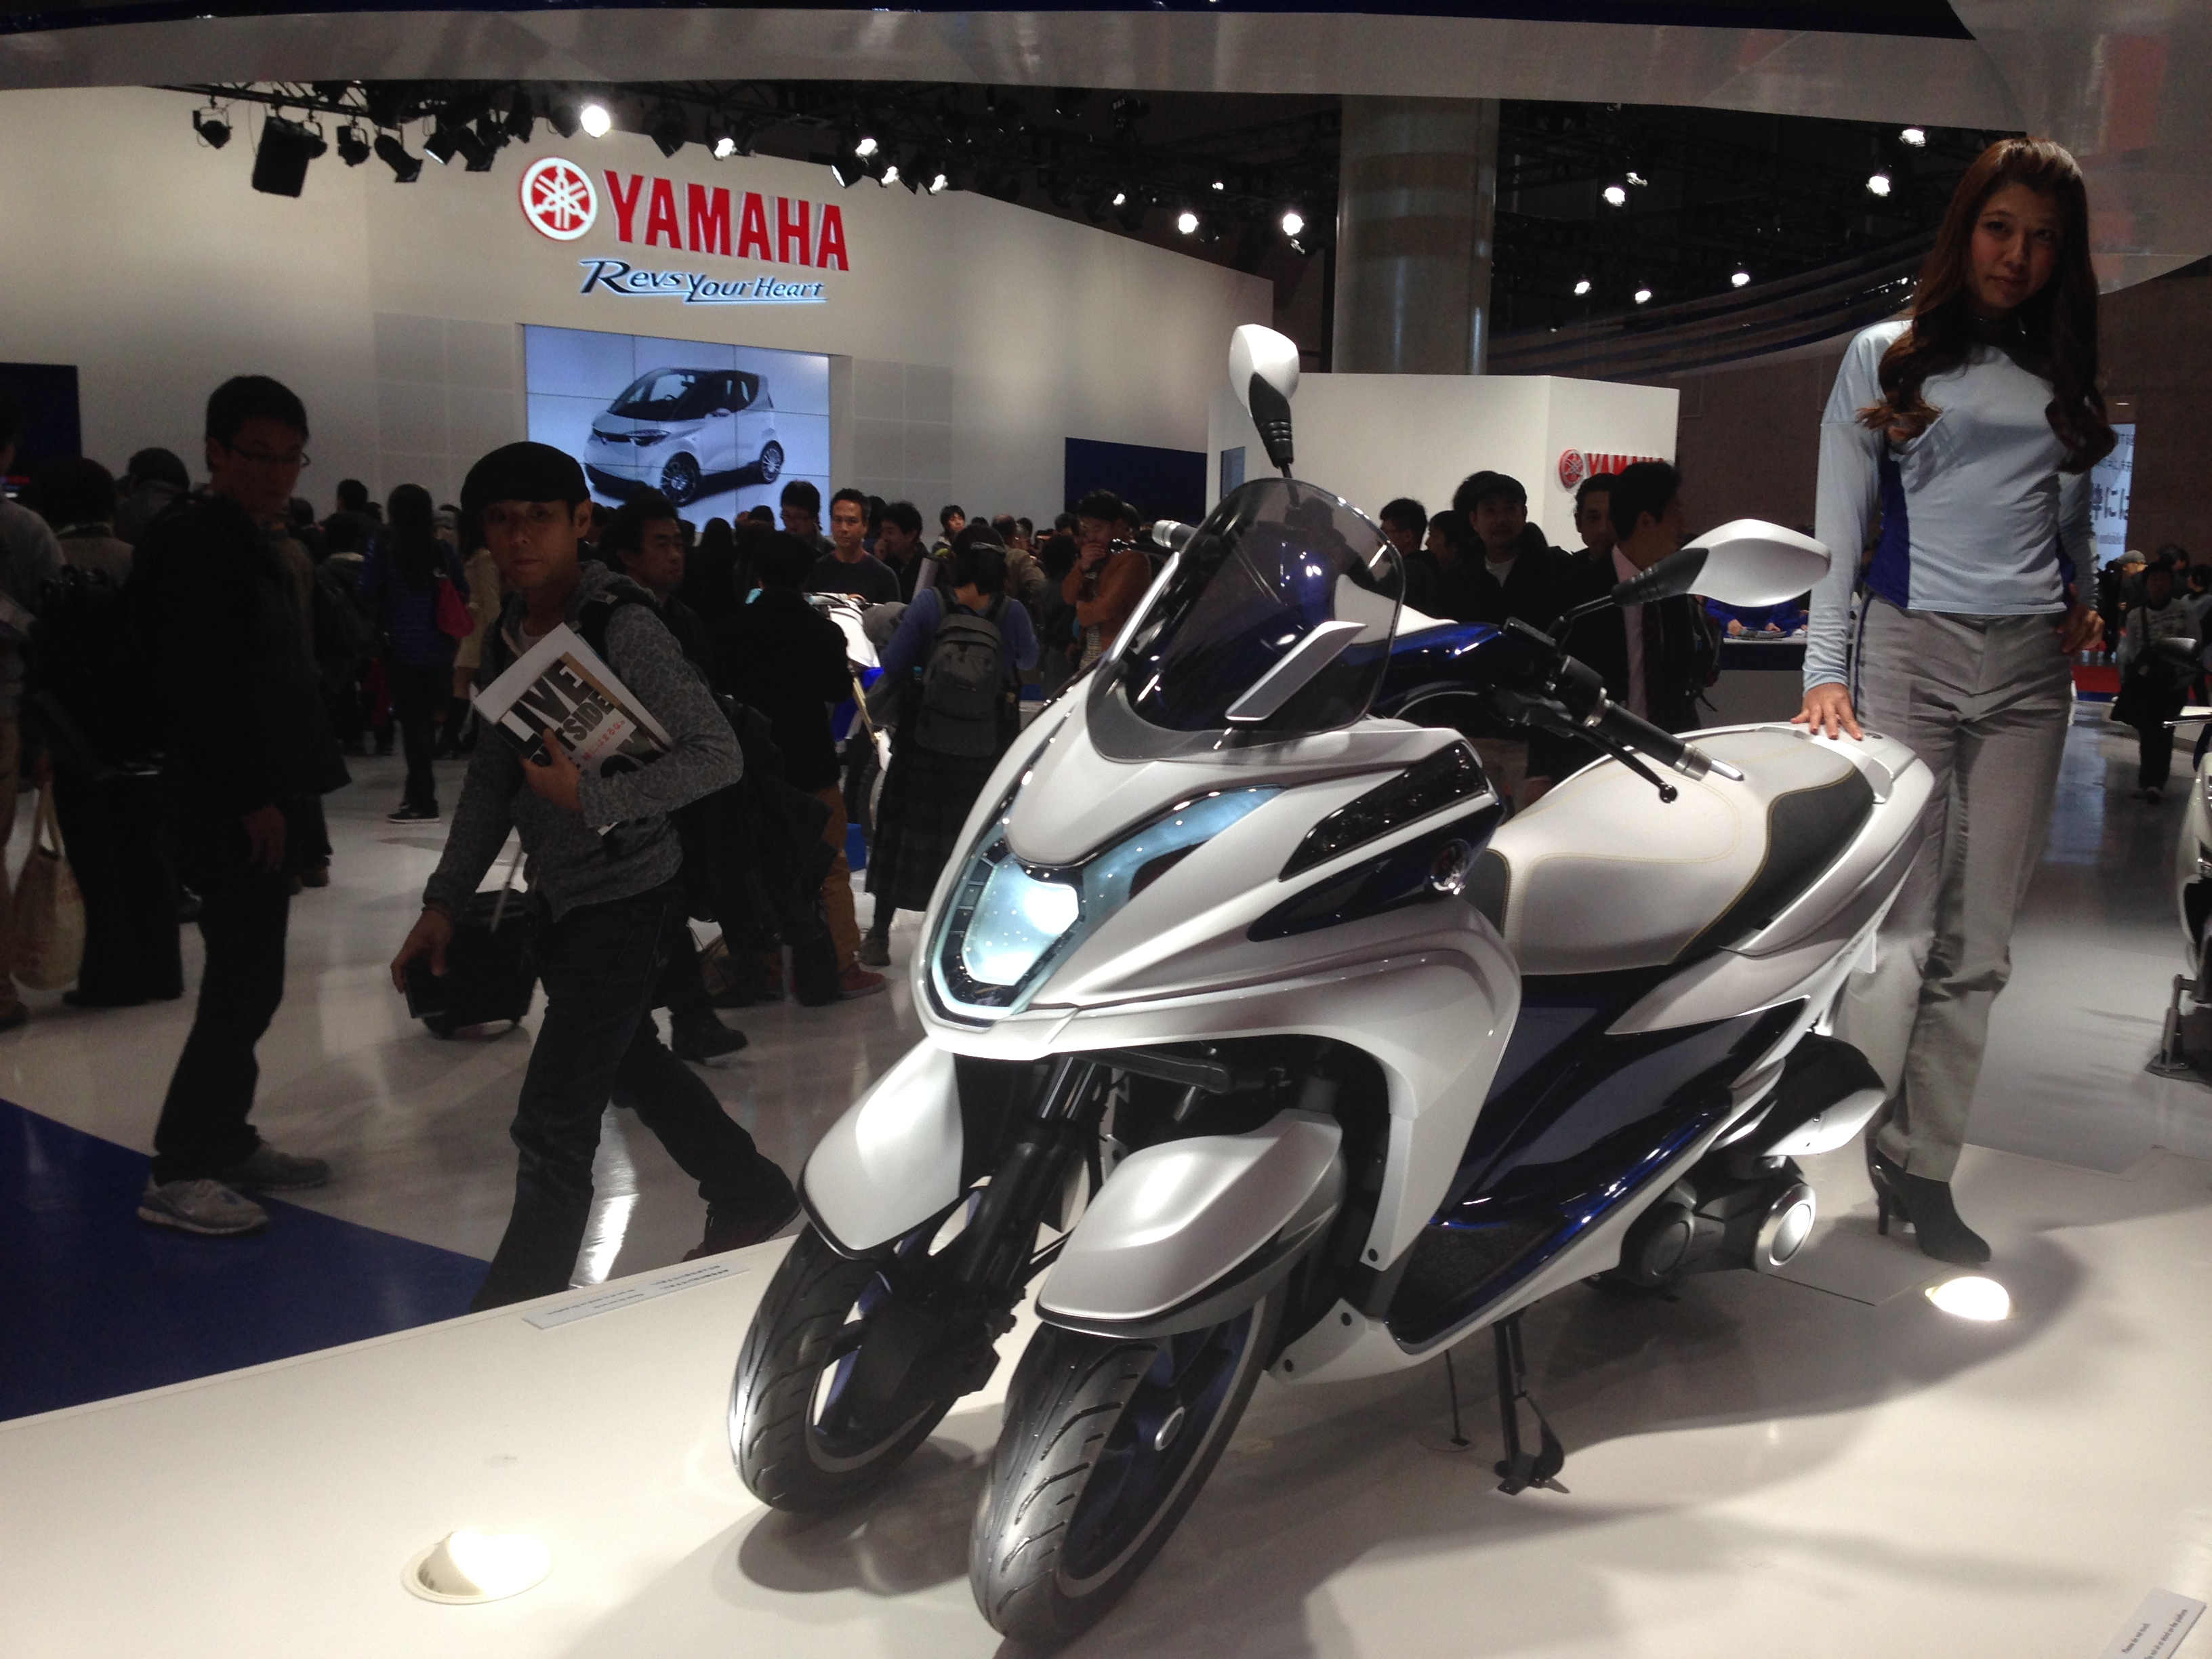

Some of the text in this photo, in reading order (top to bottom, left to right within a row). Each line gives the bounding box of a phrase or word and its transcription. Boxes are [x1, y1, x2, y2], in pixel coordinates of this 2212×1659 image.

[602, 169, 849, 271] YAMAHA
[579, 258, 825, 304] Revs Your Heart
[1584, 453, 1664, 476] YAM
[494, 657, 596, 758] LIVE
